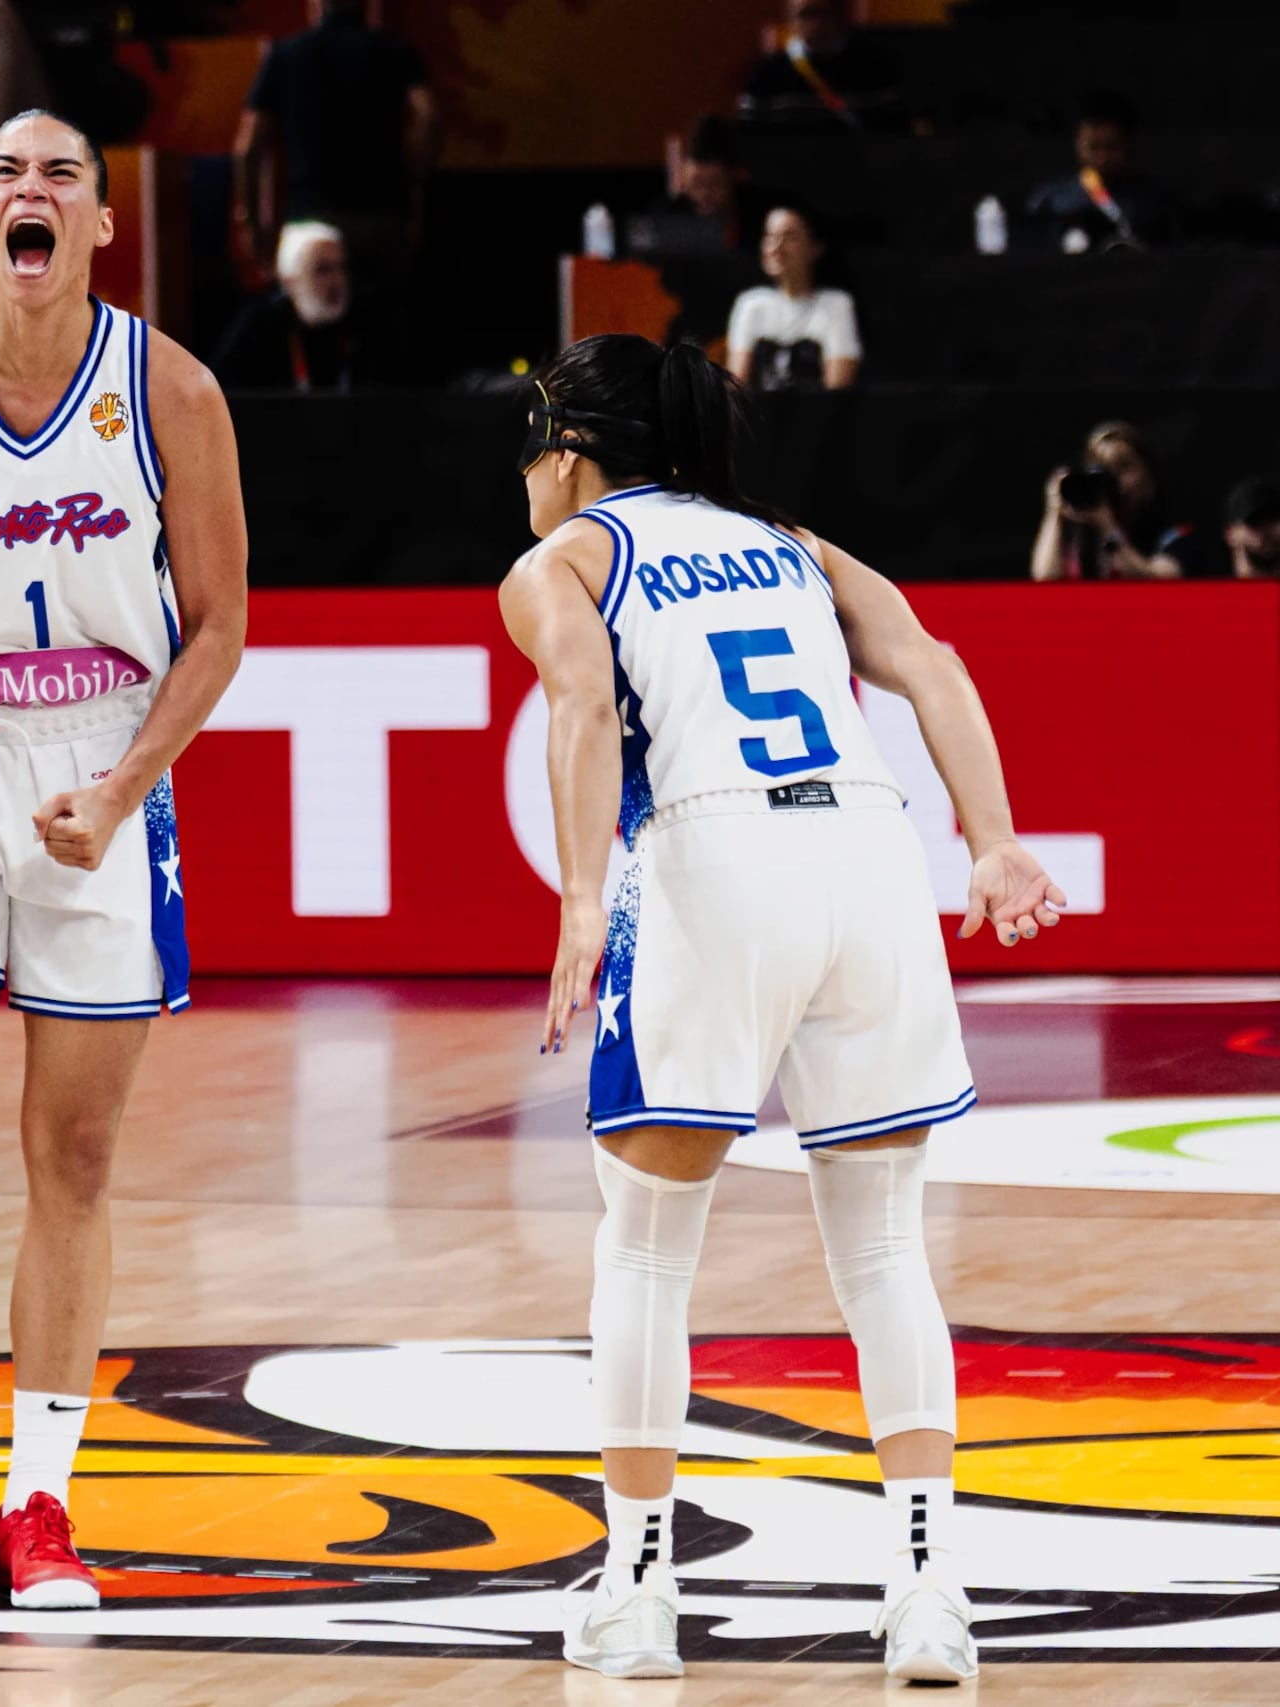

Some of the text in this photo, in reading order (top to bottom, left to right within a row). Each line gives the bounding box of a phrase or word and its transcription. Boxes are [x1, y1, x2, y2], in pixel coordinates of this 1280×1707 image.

[49, 492, 131, 554] Rico
[634, 547, 806, 612] ROSADO
[25, 581, 51, 648] 1
[706, 628, 840, 778] 5
